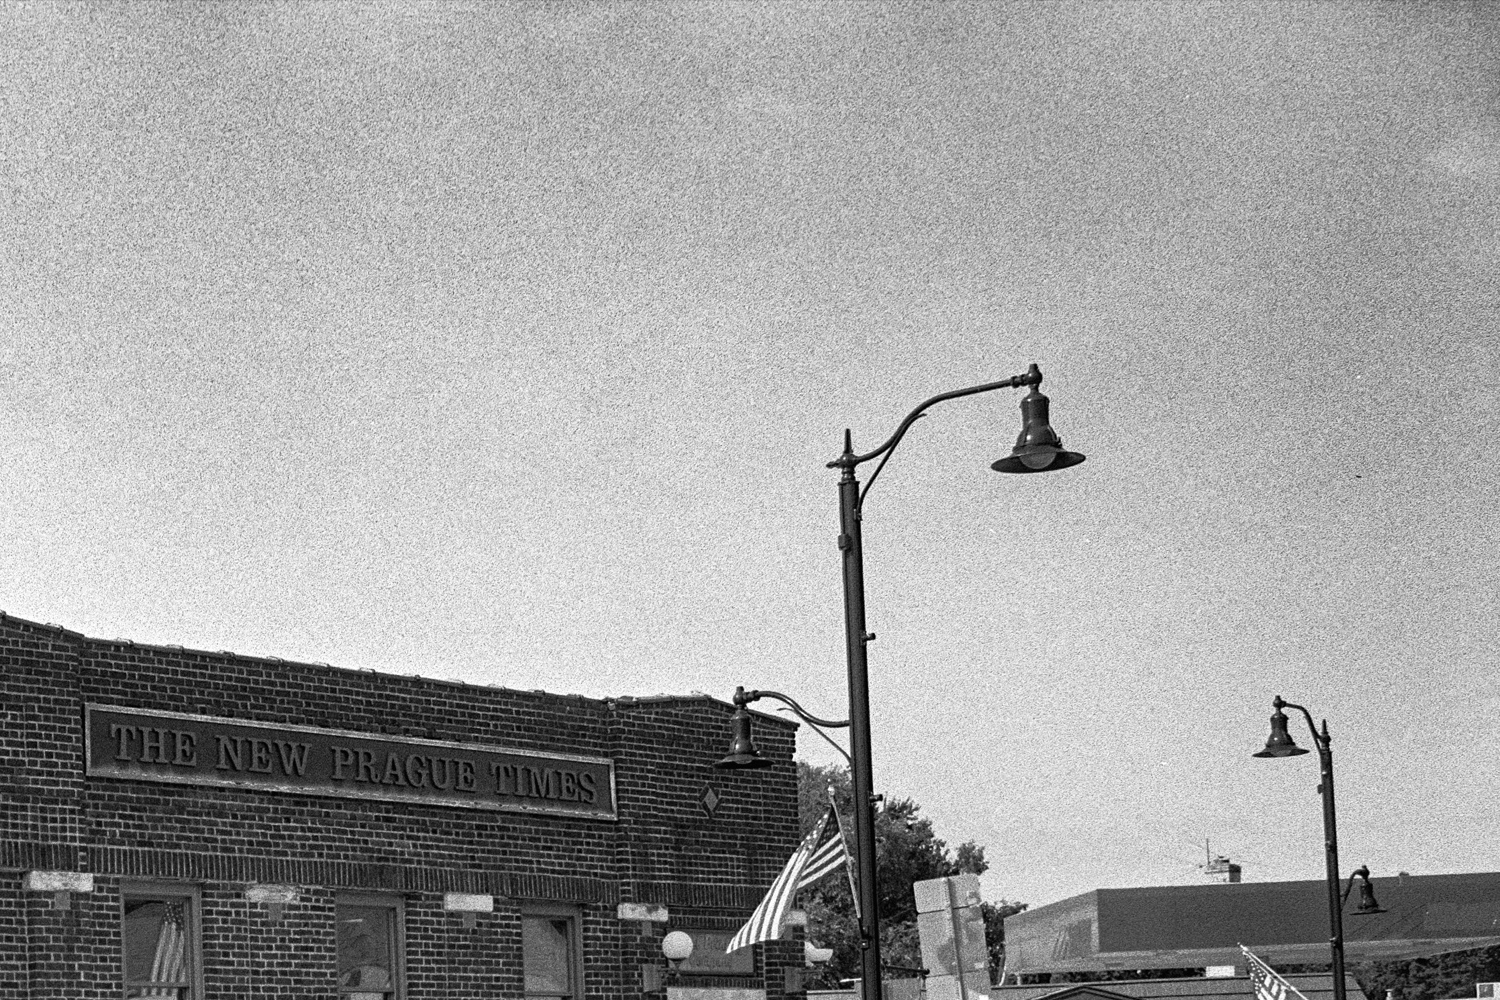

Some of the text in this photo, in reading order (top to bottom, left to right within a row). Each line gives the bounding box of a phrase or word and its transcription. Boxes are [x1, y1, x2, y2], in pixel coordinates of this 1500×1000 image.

[111, 722, 599, 803] THE NEW PRAGUE TIMES
